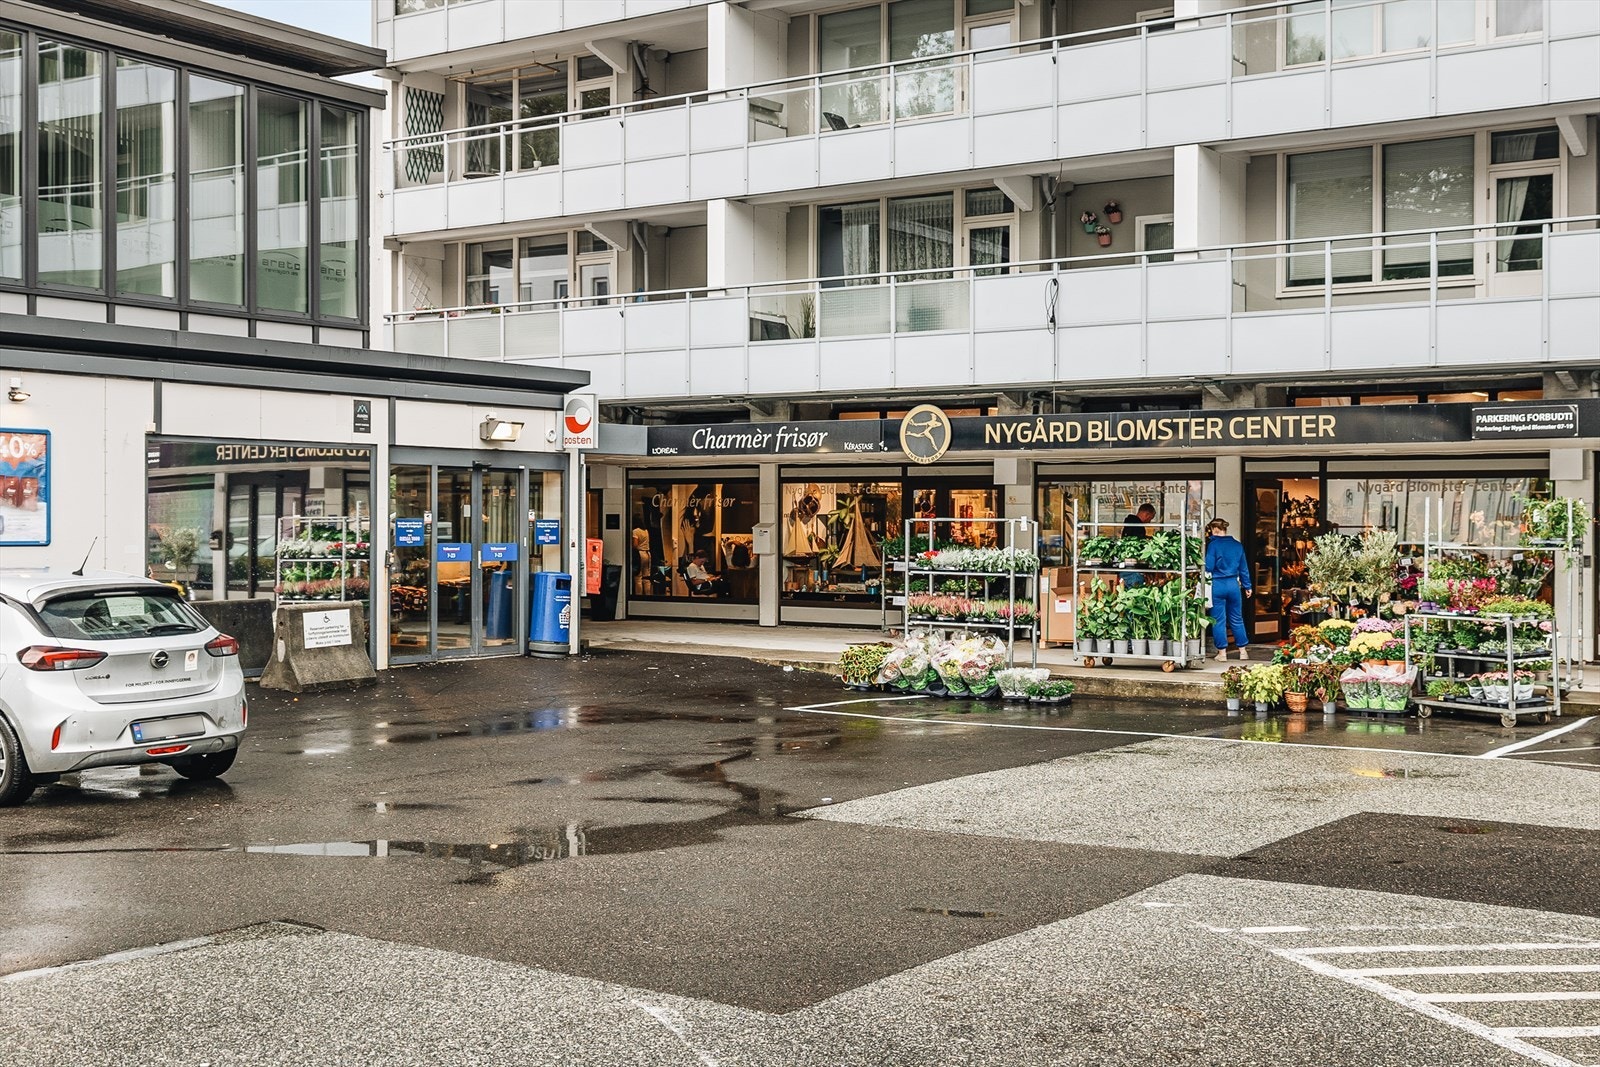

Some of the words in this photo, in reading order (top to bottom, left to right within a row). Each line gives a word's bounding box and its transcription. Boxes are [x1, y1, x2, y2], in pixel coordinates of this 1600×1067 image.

[262, 258, 300, 271] areto
[1476, 414, 1526, 423] PARKERING
[985, 417, 1082, 444] NYGÅRD
[1088, 417, 1223, 442] BLOMSTER
[1229, 414, 1336, 439] CENTER
[1476, 424, 1502, 433] Parkering
[1511, 423, 1532, 432] Nygård
[1532, 423, 1557, 431] Blomster
[564, 436, 592, 446] posten
[692, 427, 772, 450] Charmèr
[775, 425, 828, 453] frisør
[844, 441, 874, 450] KÉRASTASE
[1100, 483, 1192, 494] Blomster-center
[1357, 480, 1403, 494] Nygård
[1407, 480, 1517, 493] Blomster-center
